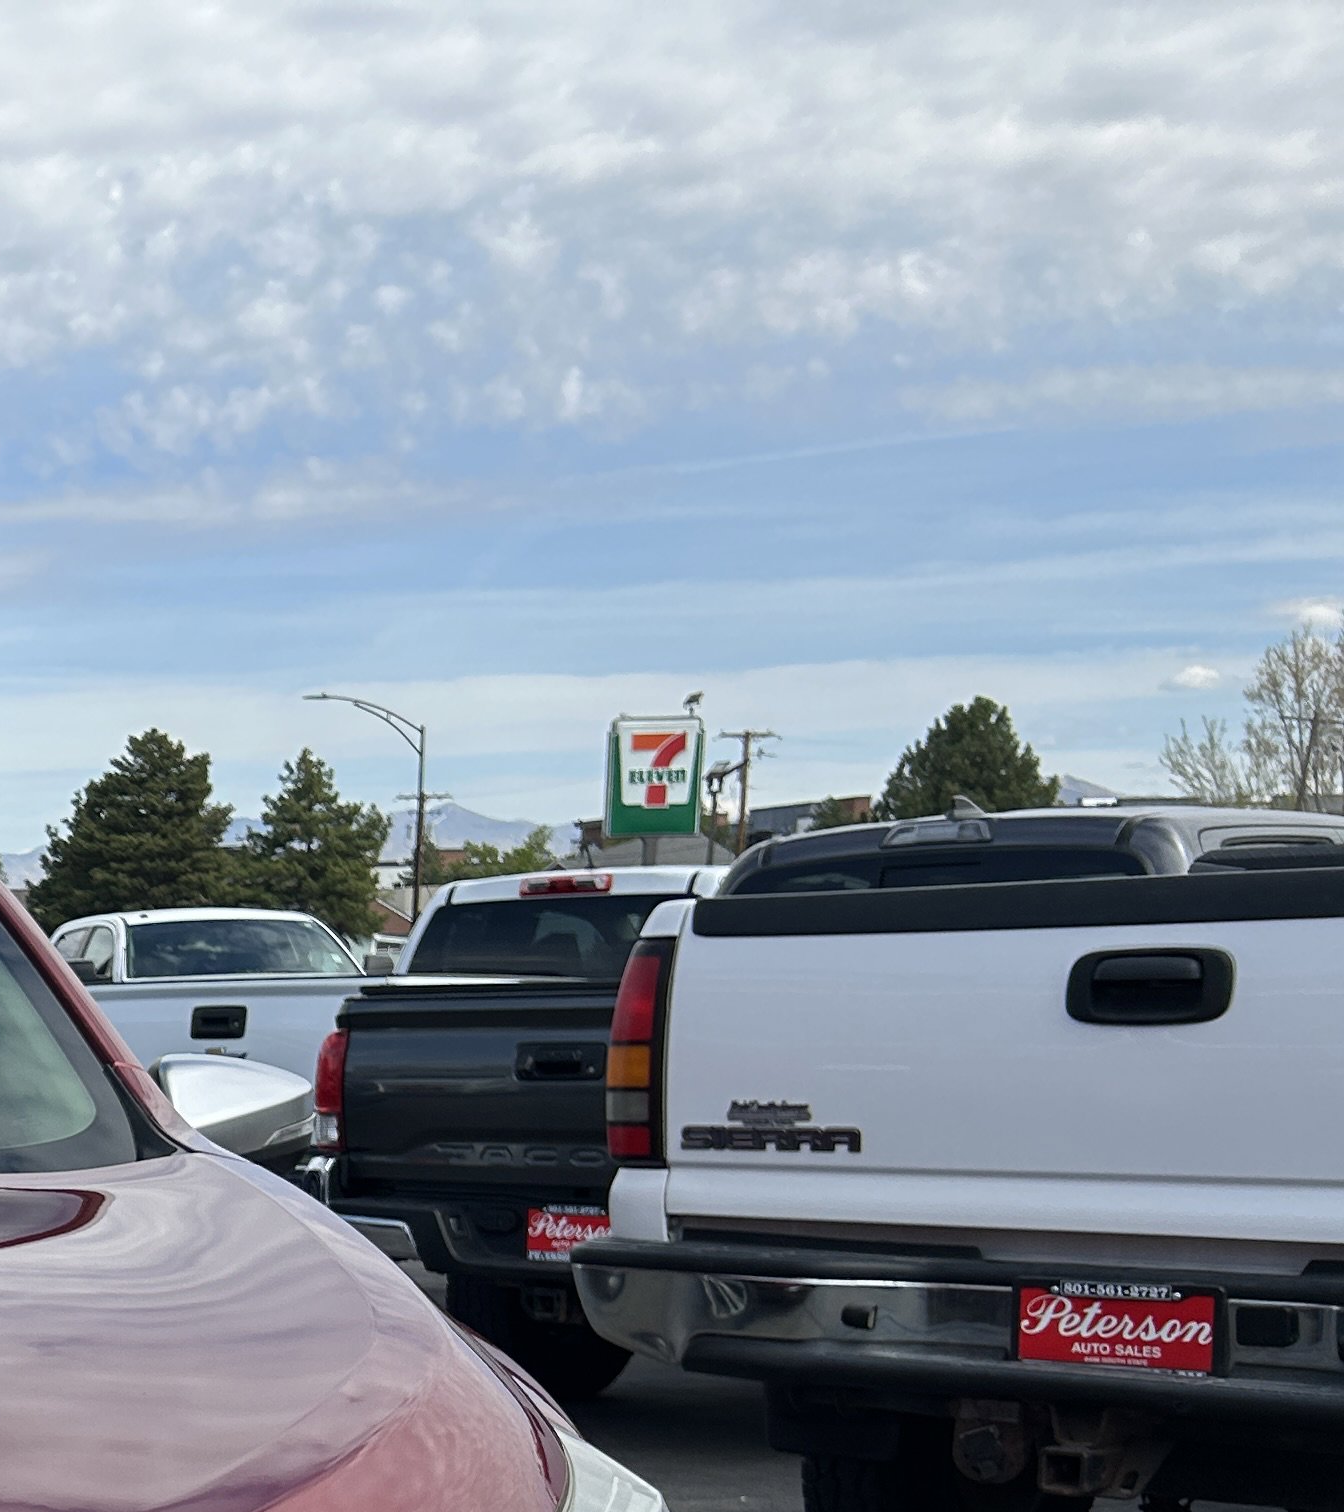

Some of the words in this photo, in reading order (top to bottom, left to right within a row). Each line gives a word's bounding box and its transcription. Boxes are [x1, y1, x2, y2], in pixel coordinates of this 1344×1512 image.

[631, 734, 687, 806] 7
[681, 1126, 861, 1152] SIERRA
[434, 1142, 608, 1168] TACO
[1020, 1294, 1213, 1345] Peterson
[1071, 1341, 1110, 1355] AUTO
[1115, 1344, 1161, 1359] SALES
